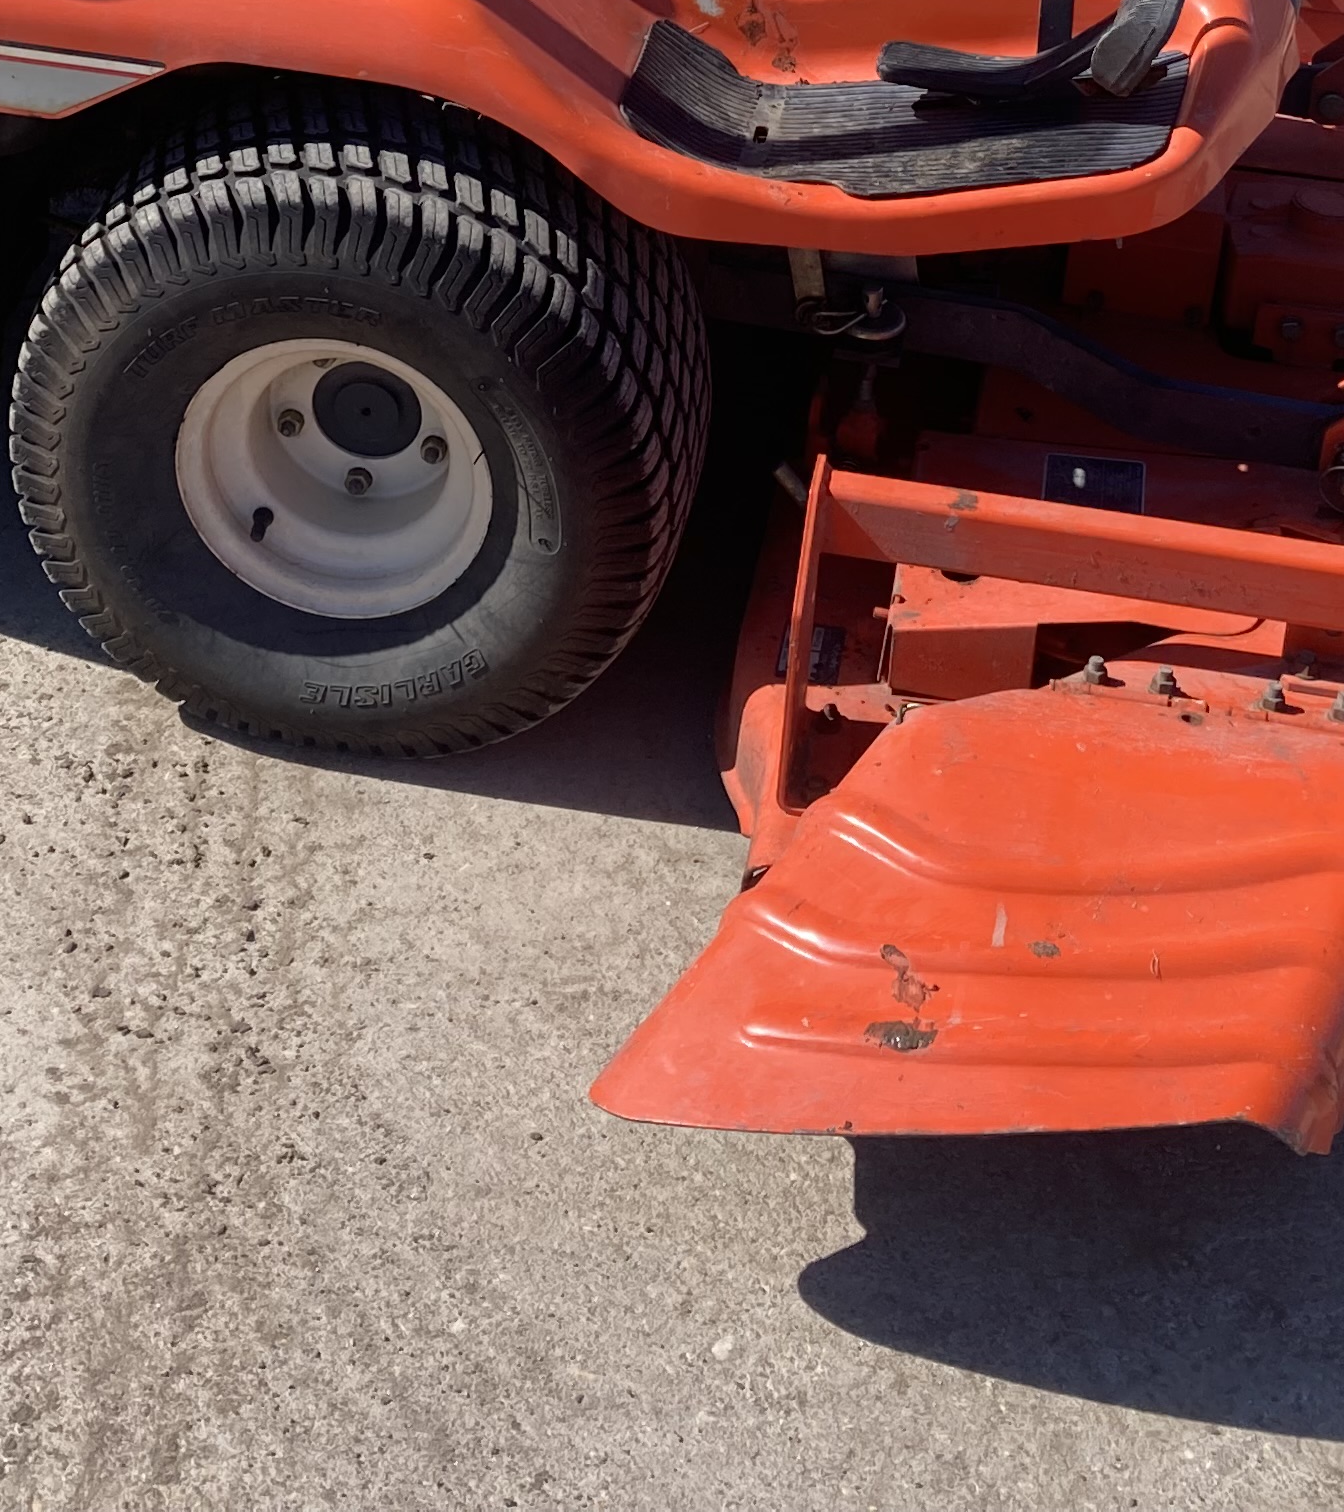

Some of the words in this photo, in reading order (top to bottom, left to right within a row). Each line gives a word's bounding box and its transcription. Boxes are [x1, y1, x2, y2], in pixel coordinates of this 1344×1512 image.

[122, 316, 198, 378] TURF
[210, 296, 382, 327] MASTER
[299, 648, 490, 708] CARLISLE
